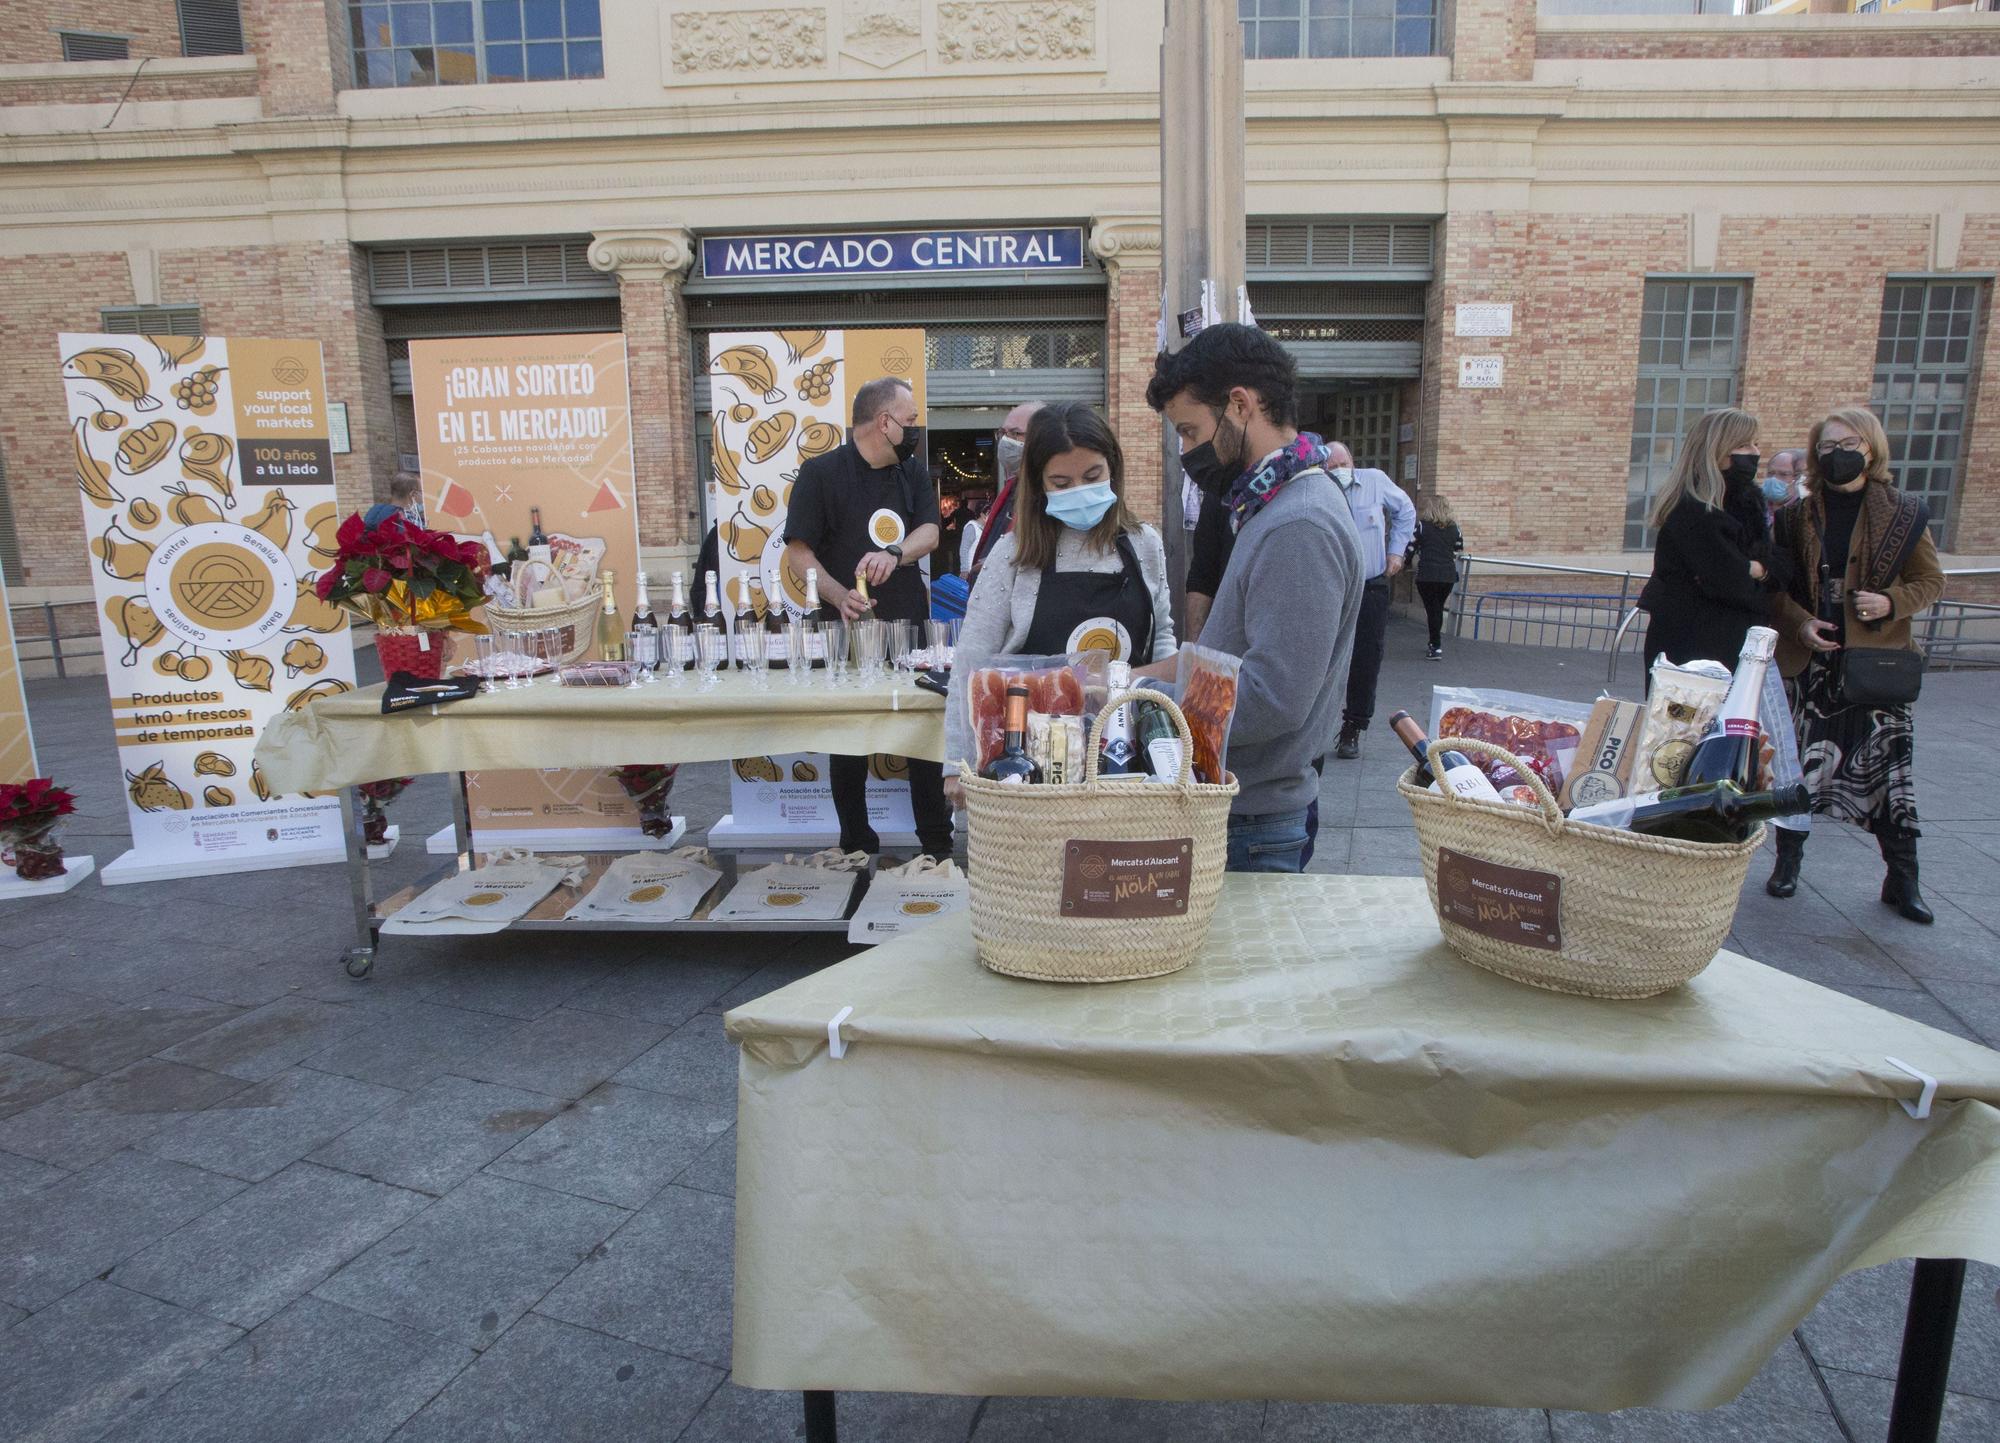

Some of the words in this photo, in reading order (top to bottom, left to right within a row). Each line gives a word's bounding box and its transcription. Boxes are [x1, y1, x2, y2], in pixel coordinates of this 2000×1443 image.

[725, 239, 893, 271] MERCADO
[911, 234, 1061, 266] CENTRAL
[445, 366, 510, 406] ¡GRAN
[515, 363, 595, 396] SORTEO
[256, 389, 311, 402] support
[243, 403, 276, 416] your
[279, 402, 312, 415] local
[256, 416, 314, 429] markets
[438, 412, 466, 443] EN
[471, 411, 496, 442] EL
[500, 407, 609, 441] MERCADO!
[254, 448, 280, 462] 100
[283, 448, 317, 461] años
[458, 455, 507, 467] productos
[511, 455, 522, 464] de
[525, 455, 539, 464] los
[256, 465, 265, 475] a
[269, 463, 284, 475] tu
[287, 463, 319, 475] lado
[158, 536, 189, 565] Central
[243, 534, 279, 565] Benalúa
[164, 608, 206, 641] Carolinas
[259, 611, 283, 634] Babel
[132, 688, 218, 705] Productos
[136, 711, 173, 725] km0
[187, 707, 248, 721] frescos
[138, 729, 157, 743] de
[163, 724, 254, 742] temporada
[1599, 737, 1622, 769] PICO
[1052, 762, 1063, 784] PIC
[190, 811, 229, 821] Asociación
[241, 808, 288, 817] Comerciantes
[289, 803, 341, 813] Concesionarios
[1111, 858, 1143, 867] Mercats
[1115, 873, 1158, 902] MOLA
[1472, 878, 1502, 893] Mercats
[1478, 902, 1521, 922] MOLA
